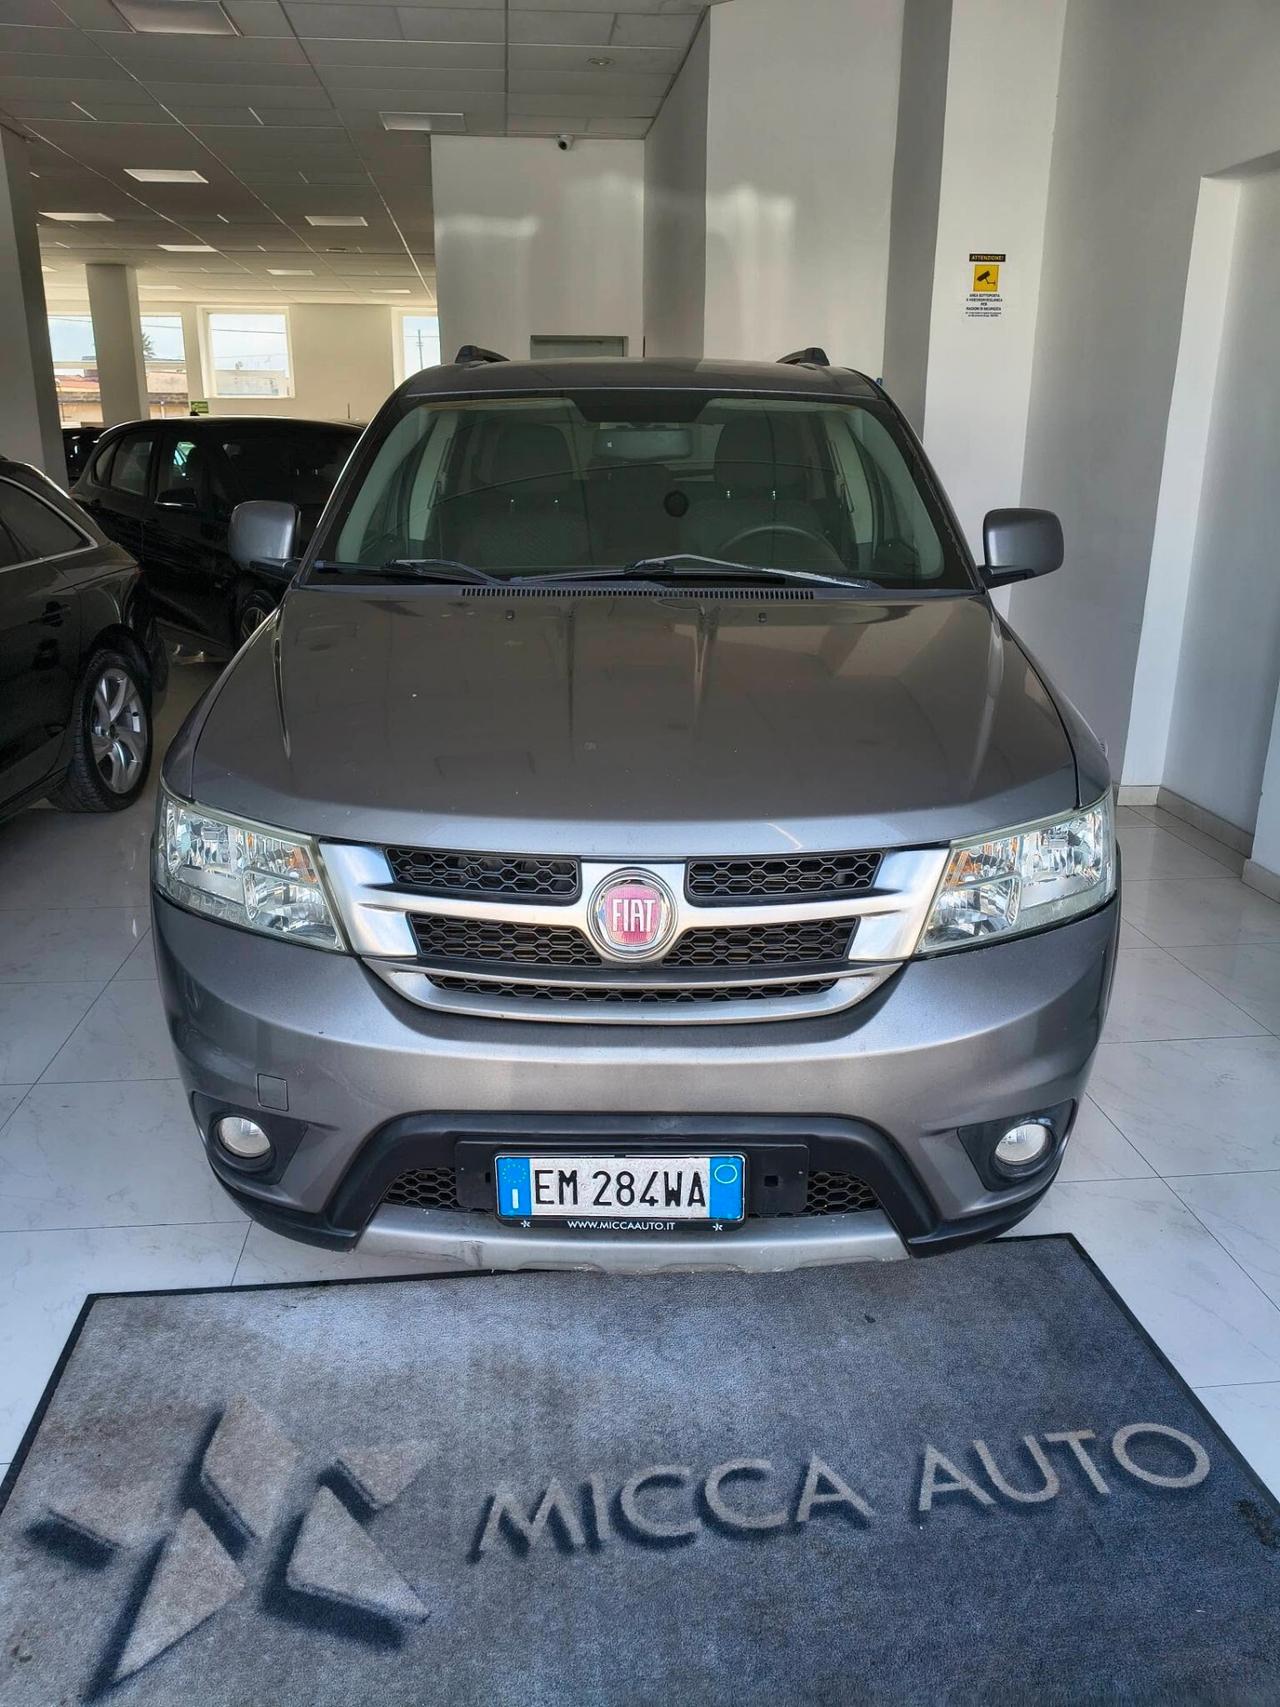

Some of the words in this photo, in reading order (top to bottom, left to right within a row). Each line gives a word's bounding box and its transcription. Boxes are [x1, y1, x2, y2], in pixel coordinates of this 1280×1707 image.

[612, 898, 655, 932] FIAT
[567, 1220, 676, 1231] WWW.MICCAAUTO.IT
[472, 1451, 876, 1556] MICCA
[917, 1422, 1211, 1512] AUTO
